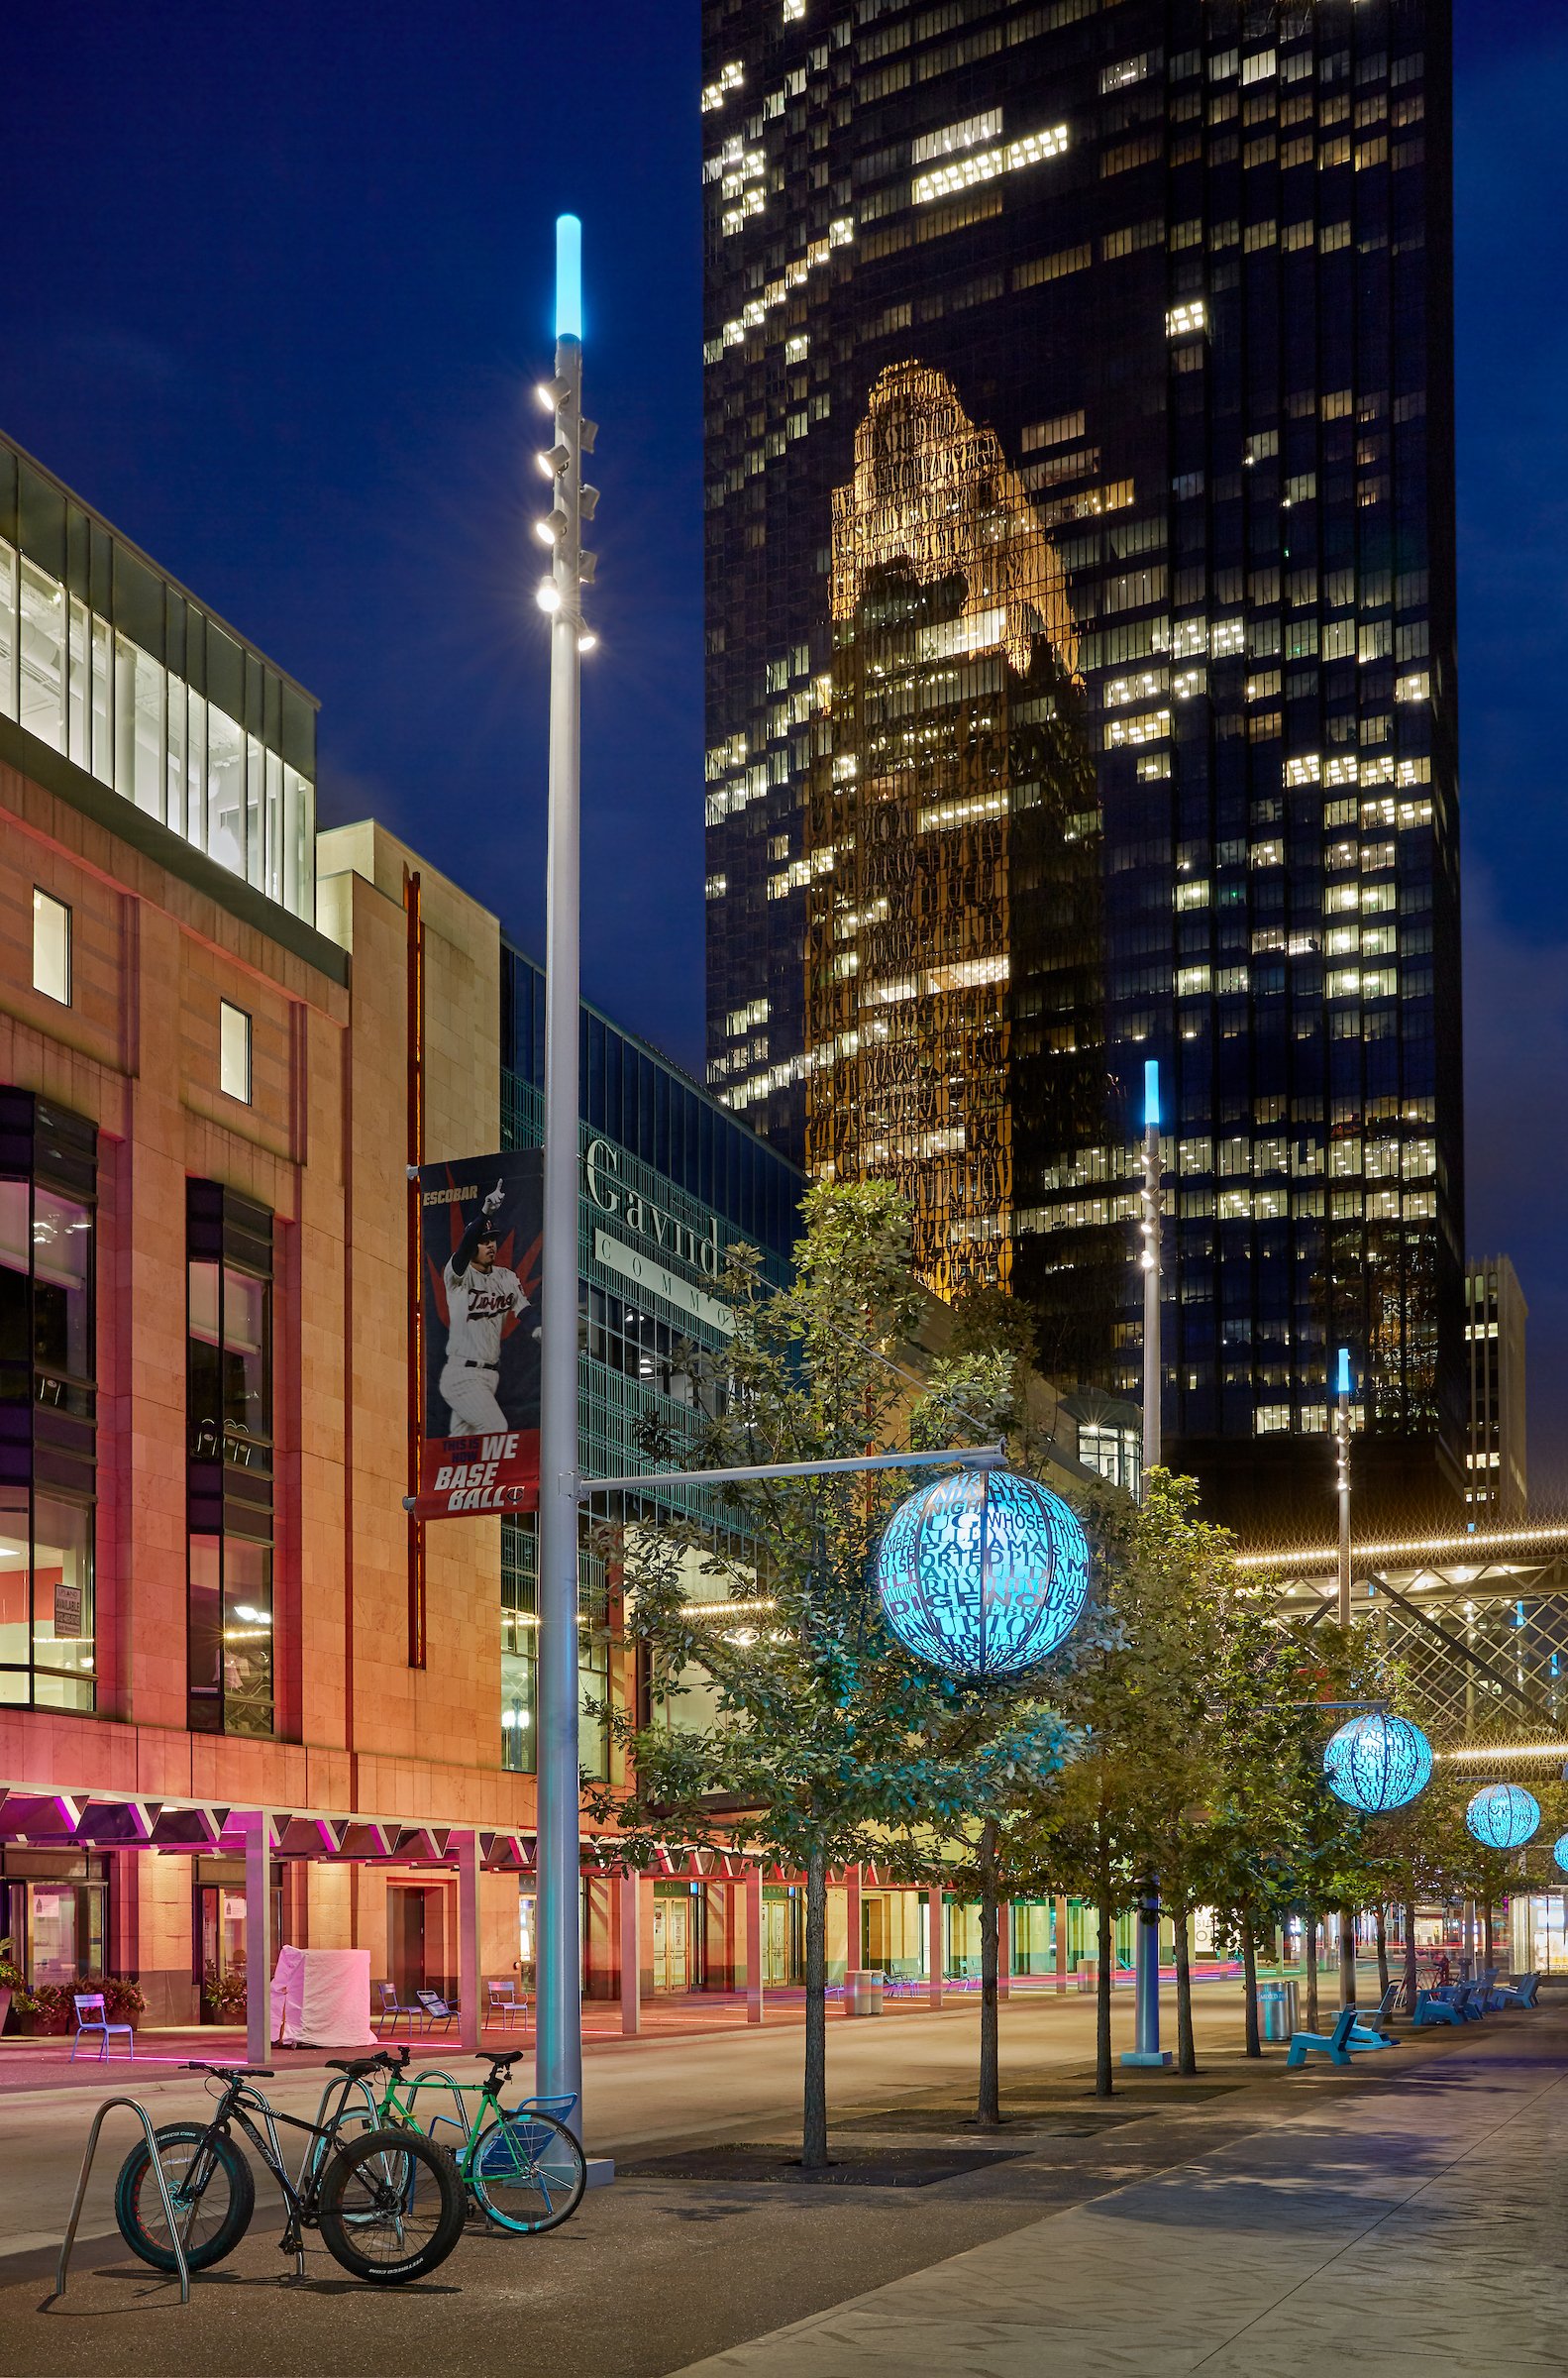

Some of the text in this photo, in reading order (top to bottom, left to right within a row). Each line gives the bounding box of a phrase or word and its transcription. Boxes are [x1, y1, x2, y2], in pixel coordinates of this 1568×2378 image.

[422, 1184, 479, 1207] ESCOBAR
[586, 1138, 719, 1281] Gaviid
[600, 1238, 733, 1327] COMMO
[443, 1433, 521, 1461] THIS IS WE
[451, 1451, 477, 1463] HOW
[434, 1461, 500, 1491] BASE
[447, 1484, 507, 1512] BALL
[988, 1512, 1045, 1531] WHOSE
[664, 1883, 673, 1892] 65
